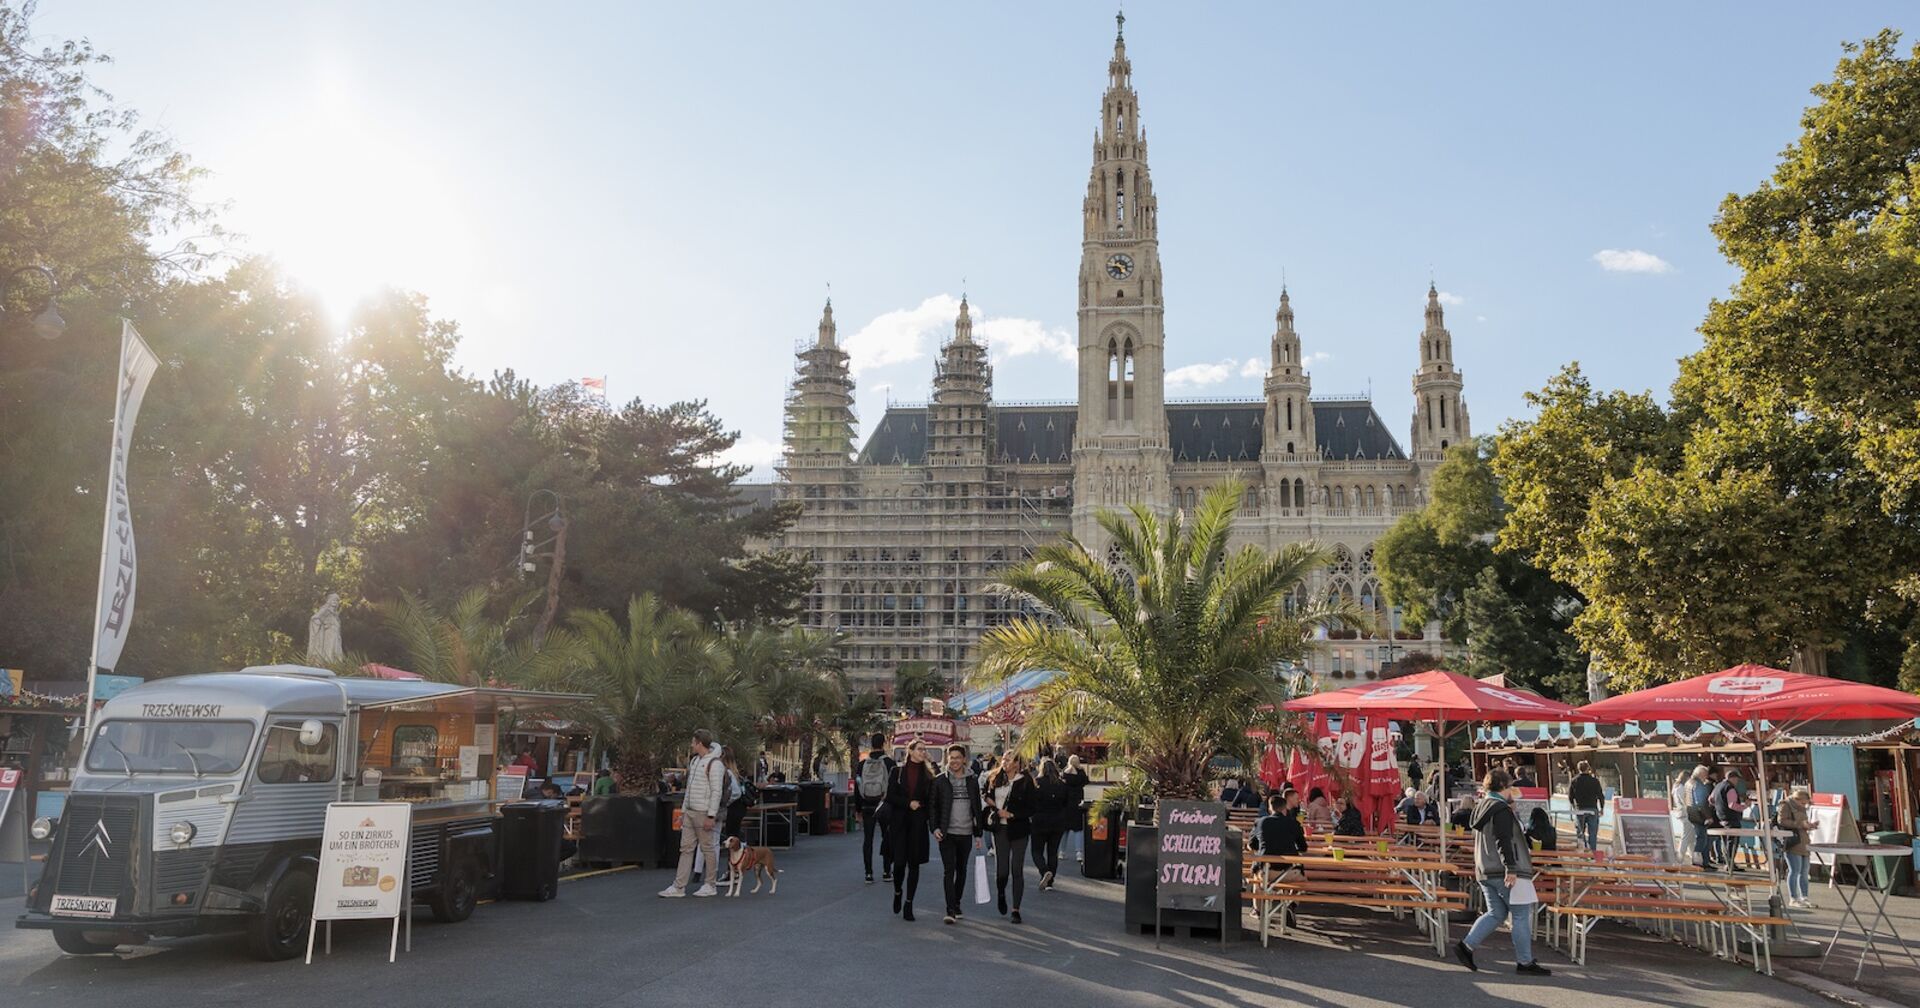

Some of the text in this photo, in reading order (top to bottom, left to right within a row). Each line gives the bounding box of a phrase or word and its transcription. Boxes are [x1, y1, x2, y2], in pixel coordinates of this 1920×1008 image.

[339, 829, 393, 840] SO EIN ZIRKUS
[329, 840, 343, 850] UM
[344, 840, 358, 850] EIN
[1161, 833, 1222, 855] SCHILCHER
[1160, 862, 1222, 887] STURM
